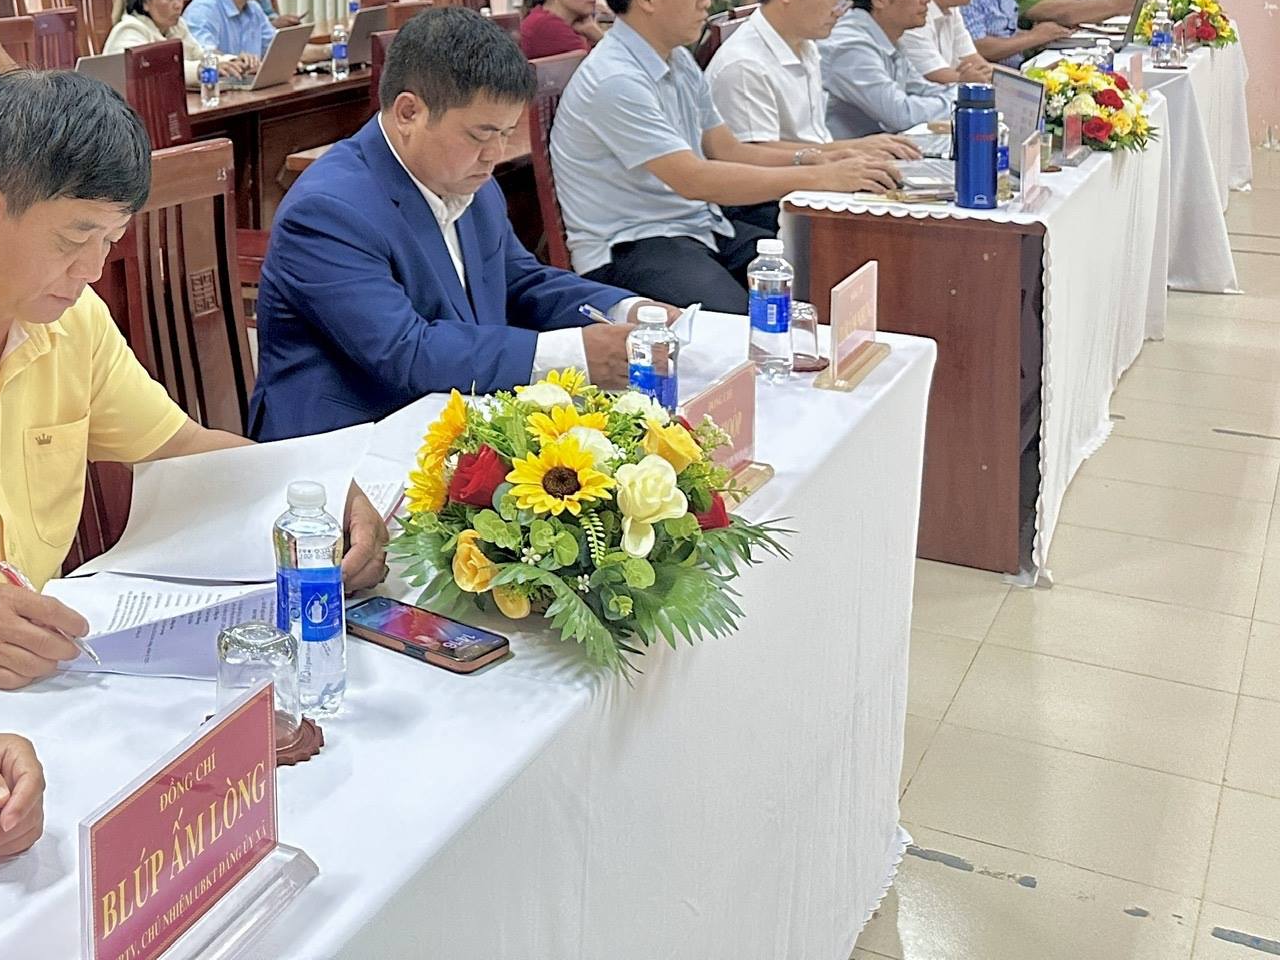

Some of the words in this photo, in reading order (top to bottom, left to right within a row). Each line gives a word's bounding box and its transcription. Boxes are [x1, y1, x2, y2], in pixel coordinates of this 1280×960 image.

[159, 771, 193, 813] ĐỒNG
[195, 748, 217, 782] CHÍ
[102, 847, 165, 940] BLÚP
[169, 807, 205, 881] ẤM
[210, 760, 267, 845] LÒNG
[141, 914, 161, 949] CHỦ
[161, 890, 193, 930] NHIỆM
[193, 867, 219, 900] UBKT
